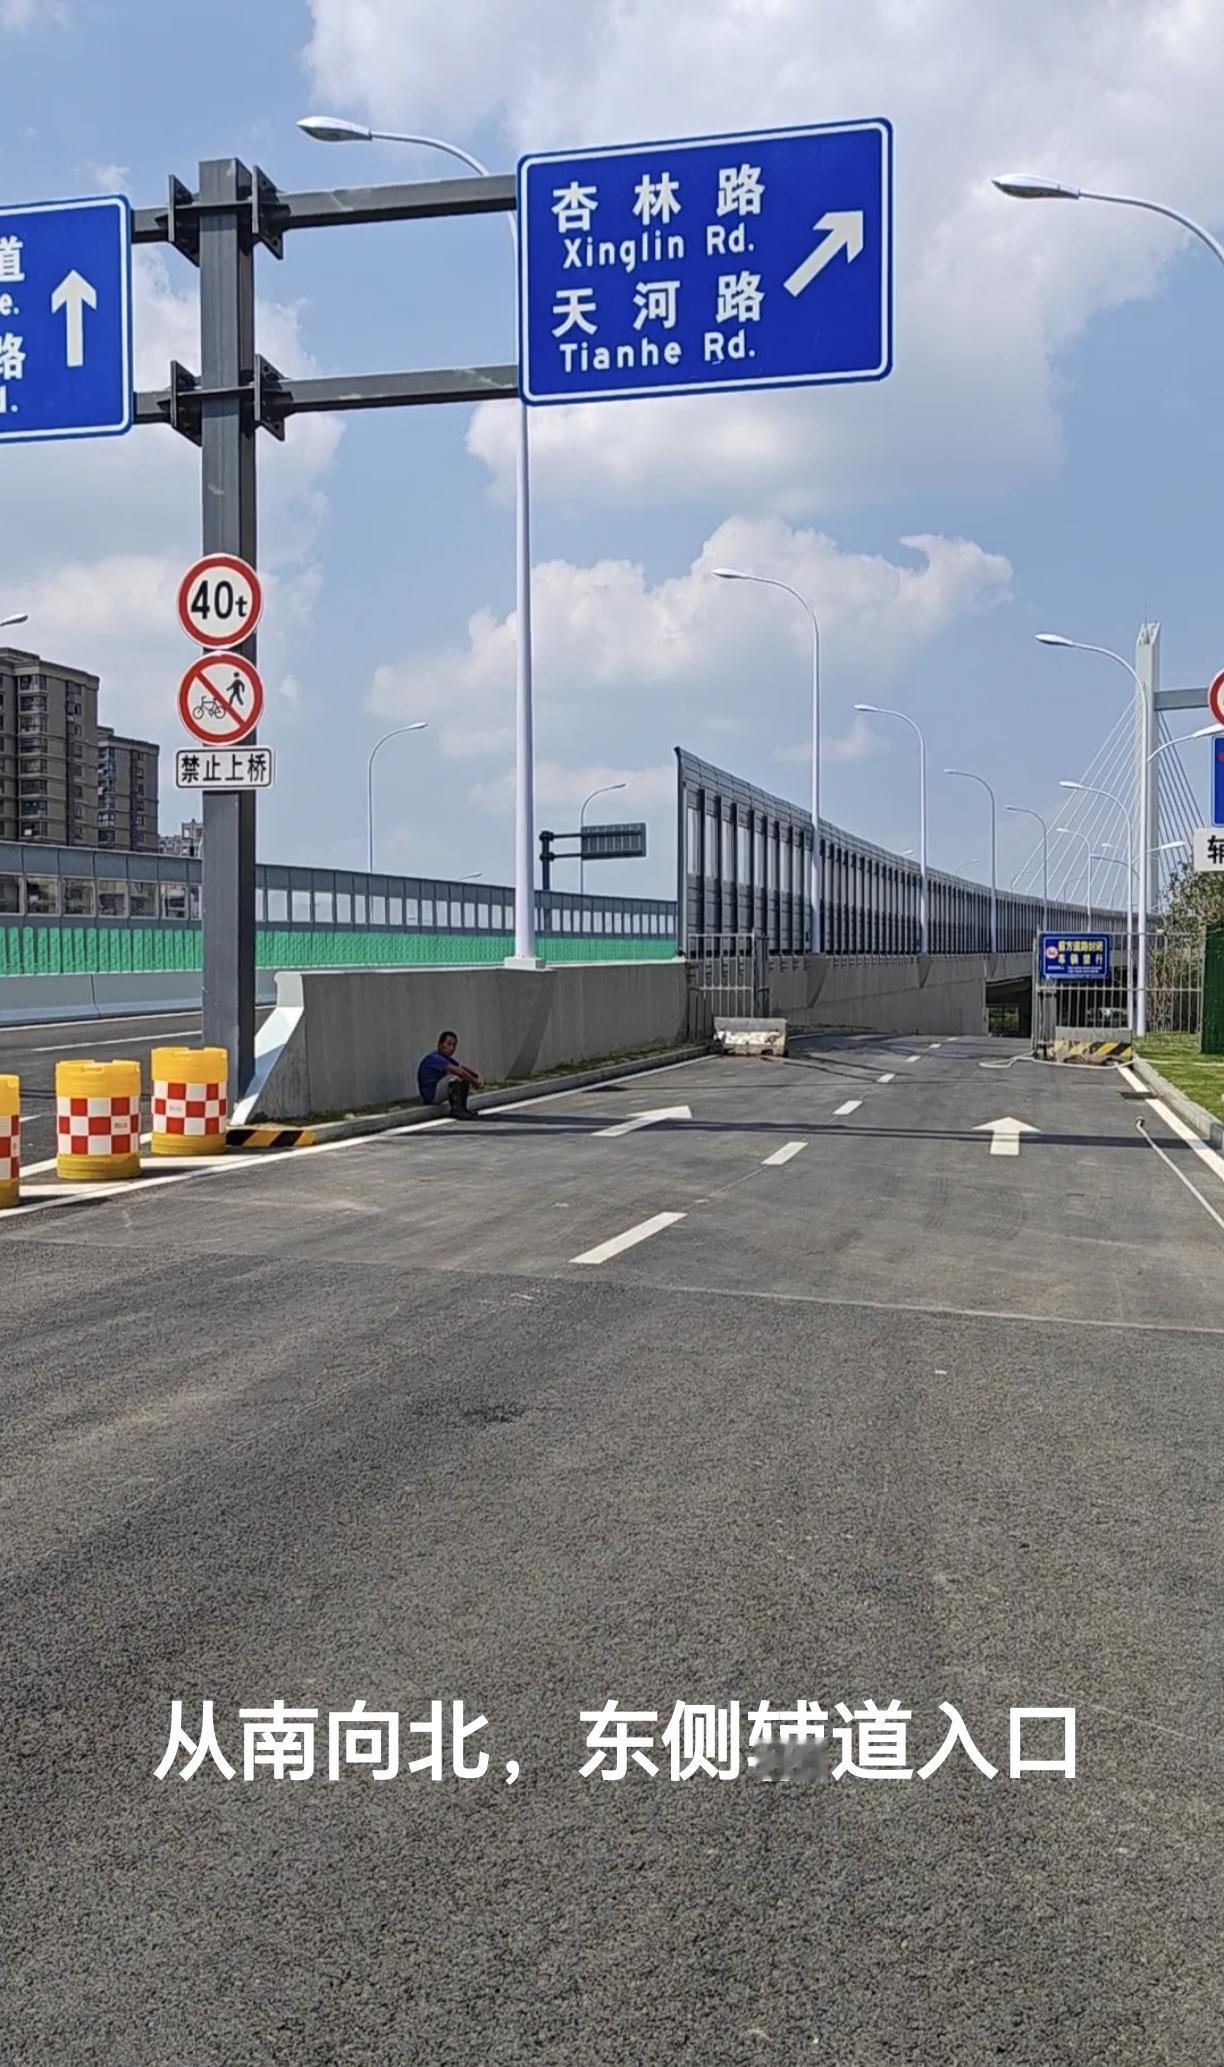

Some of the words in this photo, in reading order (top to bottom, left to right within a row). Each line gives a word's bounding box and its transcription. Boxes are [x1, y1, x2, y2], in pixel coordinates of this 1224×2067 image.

[551, 164, 765, 233] 杏林路
[562, 230, 685, 273] Xinglin
[706, 223, 755, 255] Rd.
[551, 270, 765, 338] 天河路
[559, 337, 682, 373] Tianhe
[704, 329, 756, 363] Rd.
[190, 579, 248, 620] 40t
[181, 753, 267, 784] 禁止上桥
